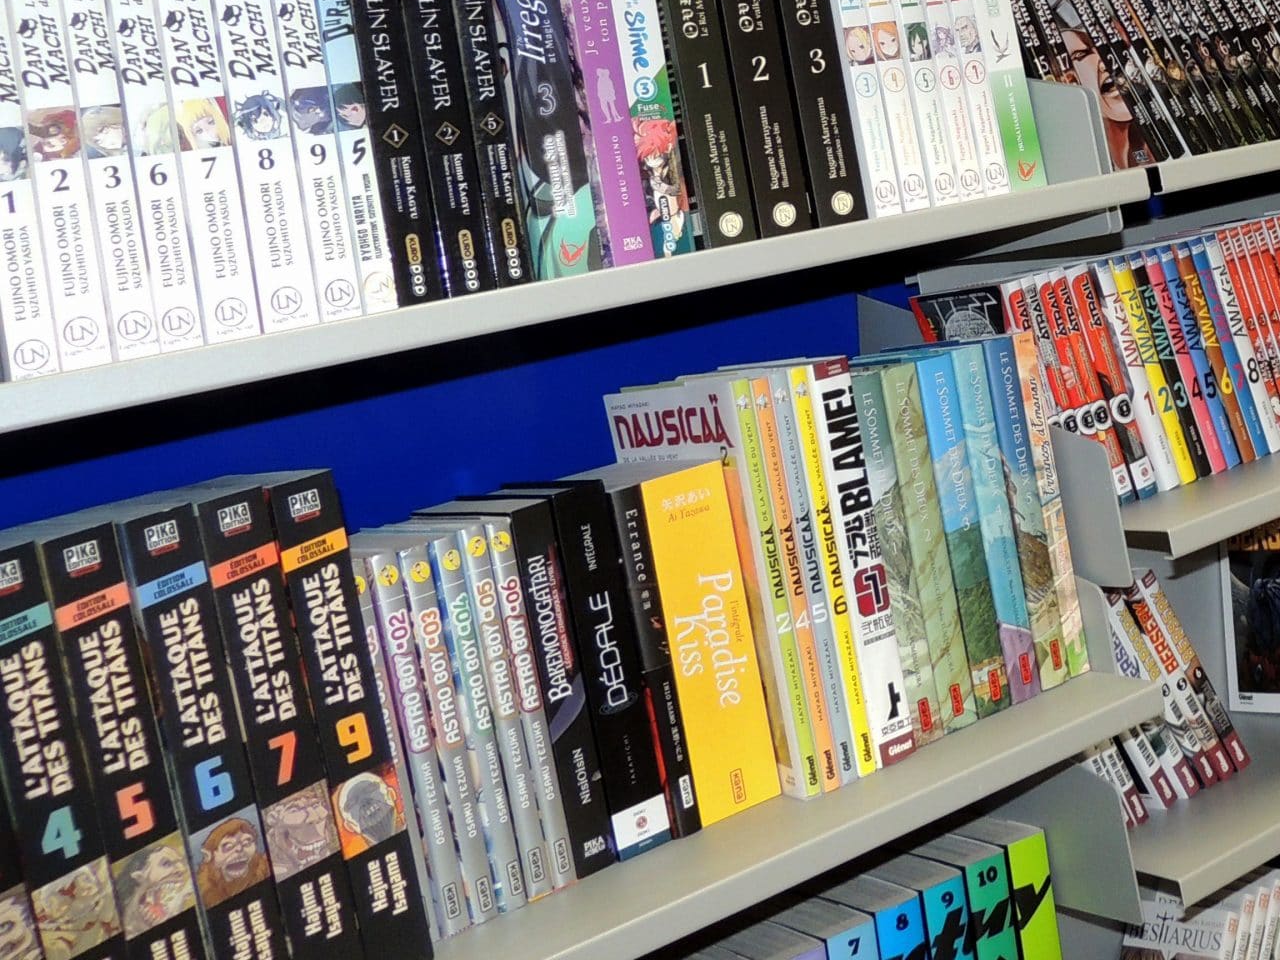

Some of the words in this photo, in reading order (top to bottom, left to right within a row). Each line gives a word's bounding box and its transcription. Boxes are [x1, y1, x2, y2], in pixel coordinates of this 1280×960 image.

[39, 14, 71, 85] MACHI
[243, 1, 277, 76] MACHI
[542, 18, 555, 48] Magic
[602, 19, 610, 42] ton
[624, 10, 649, 73] Slime
[21, 42, 50, 90] DAN
[228, 30, 257, 81] DAN
[372, 33, 399, 112] SLAYER
[424, 33, 450, 110] SLAYER
[469, 24, 495, 101] SLAYER
[697, 62, 712, 88] 1
[751, 55, 769, 82] 2
[809, 48, 826, 74] 3
[537, 83, 556, 115] 3
[637, 103, 660, 113] Fuse
[150, 163, 168, 186] 6
[201, 156, 217, 179] 7
[257, 148, 275, 170] 8
[309, 143, 327, 165] 9
[352, 137, 367, 165] 5
[612, 135, 624, 175] SUMINO
[50, 169, 70, 192] 2
[103, 165, 122, 189] 3
[618, 178, 630, 206] YORU
[1, 191, 16, 214] 1
[68, 203, 81, 242] YASUDA
[52, 205, 69, 249] OMORI
[59, 251, 75, 297] FUJINO
[74, 244, 89, 295] SUZUHITO
[1212, 265, 1248, 337] AWAKEN
[1121, 289, 1158, 364] AWAKEN
[999, 351, 1009, 366] LE
[1246, 358, 1260, 384] 8
[1001, 366, 1019, 420] SOMMET
[1158, 387, 1173, 414] 2
[720, 446, 730, 467] 2
[1011, 423, 1021, 444] DES
[1015, 445, 1032, 487] DIEUX
[626, 509, 647, 582] Errance
[252, 577, 285, 668] TITANS
[321, 562, 352, 651] TITANS
[528, 554, 572, 704] BAKEMONOGATARI
[775, 612, 793, 635] 2
[795, 610, 811, 630] 4
[833, 594, 849, 616] 6
[232, 589, 275, 724] L'ATTAQUE
[303, 573, 344, 706] L'ATTAQUE
[510, 618, 529, 651] BOY
[589, 590, 629, 707] DÉDALE
[674, 613, 706, 677] Kiss
[697, 569, 748, 708] Paradise
[1132, 600, 1179, 676] BERSERK
[101, 619, 136, 715] TITANS
[339, 653, 365, 703] DES
[516, 653, 539, 711] ASTRO
[78, 631, 126, 775] L'ATTAQUE
[272, 670, 297, 721] DES
[120, 716, 150, 772] DES
[268, 730, 297, 786] 7
[335, 712, 373, 764] 9
[532, 721, 549, 762] TEZUKA
[194, 755, 235, 811] 6
[41, 805, 82, 859] 4
[116, 782, 155, 840] 5
[368, 859, 389, 913] Hajime
[385, 851, 408, 915] Isayama
[941, 891, 954, 908] 9
[977, 866, 998, 887] 10
[896, 913, 909, 931] 8
